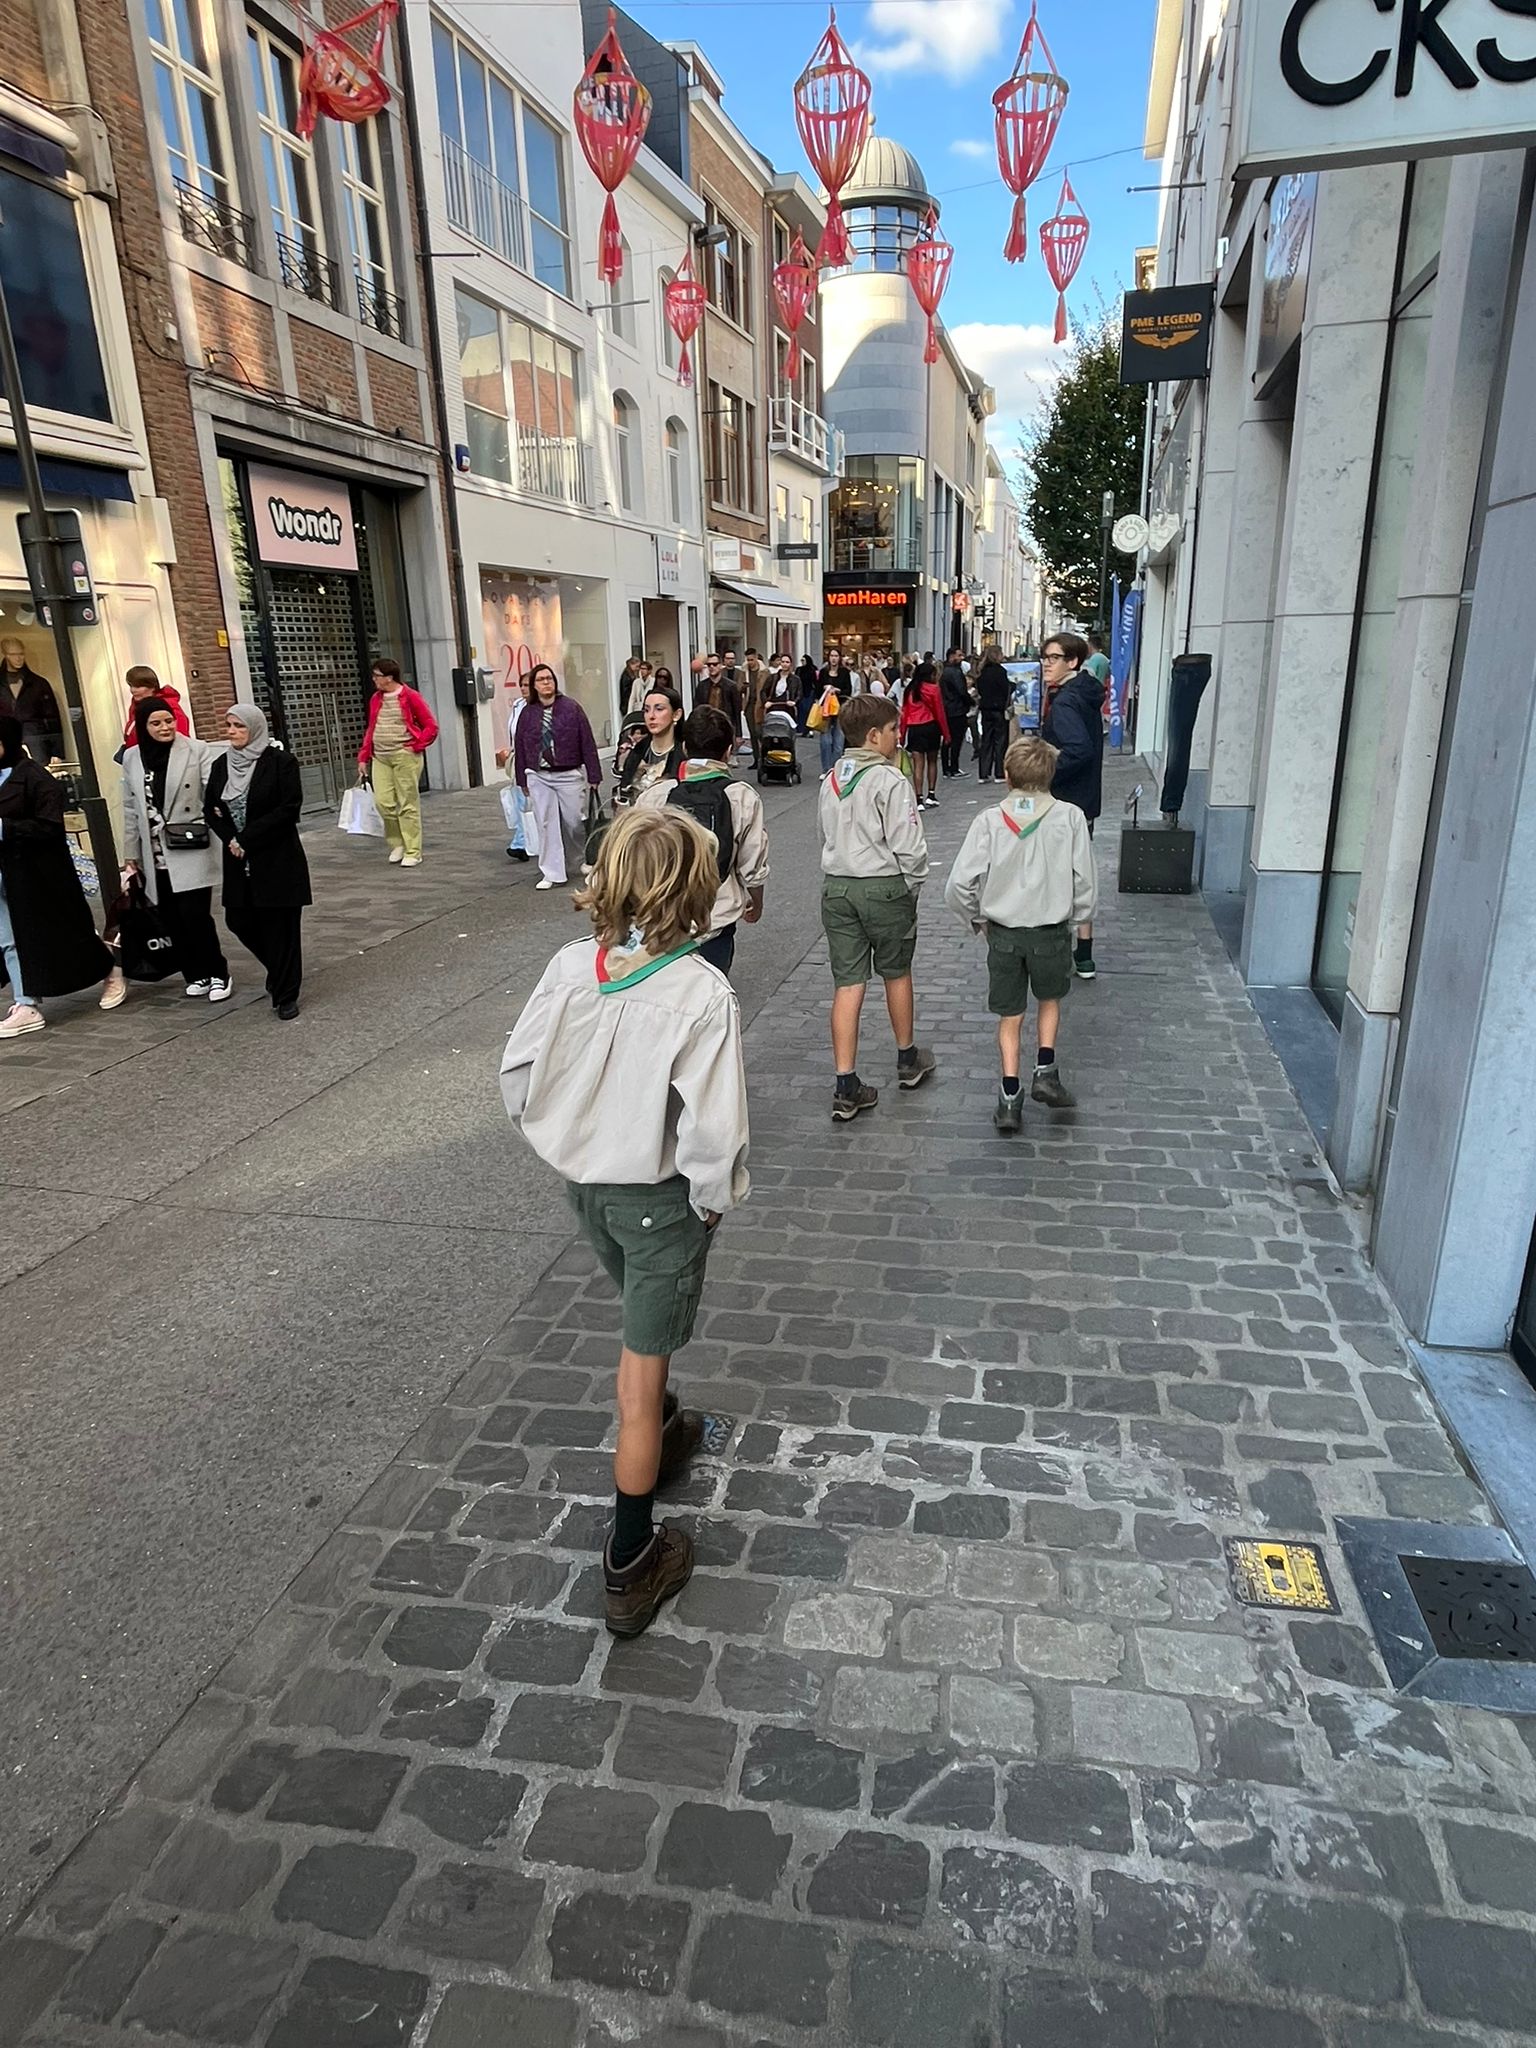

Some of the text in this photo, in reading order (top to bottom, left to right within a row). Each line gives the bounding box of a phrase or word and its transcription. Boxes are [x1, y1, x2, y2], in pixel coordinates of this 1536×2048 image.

[1280, 0, 1536, 106] CKS
[1130, 313, 1203, 328] PME LEGEND
[269, 500, 341, 542] Wondr
[661, 550, 679, 564] LOLA
[662, 569, 679, 582] LIZA
[826, 590, 908, 605] vanHaren
[983, 594, 995, 631] ONLY
